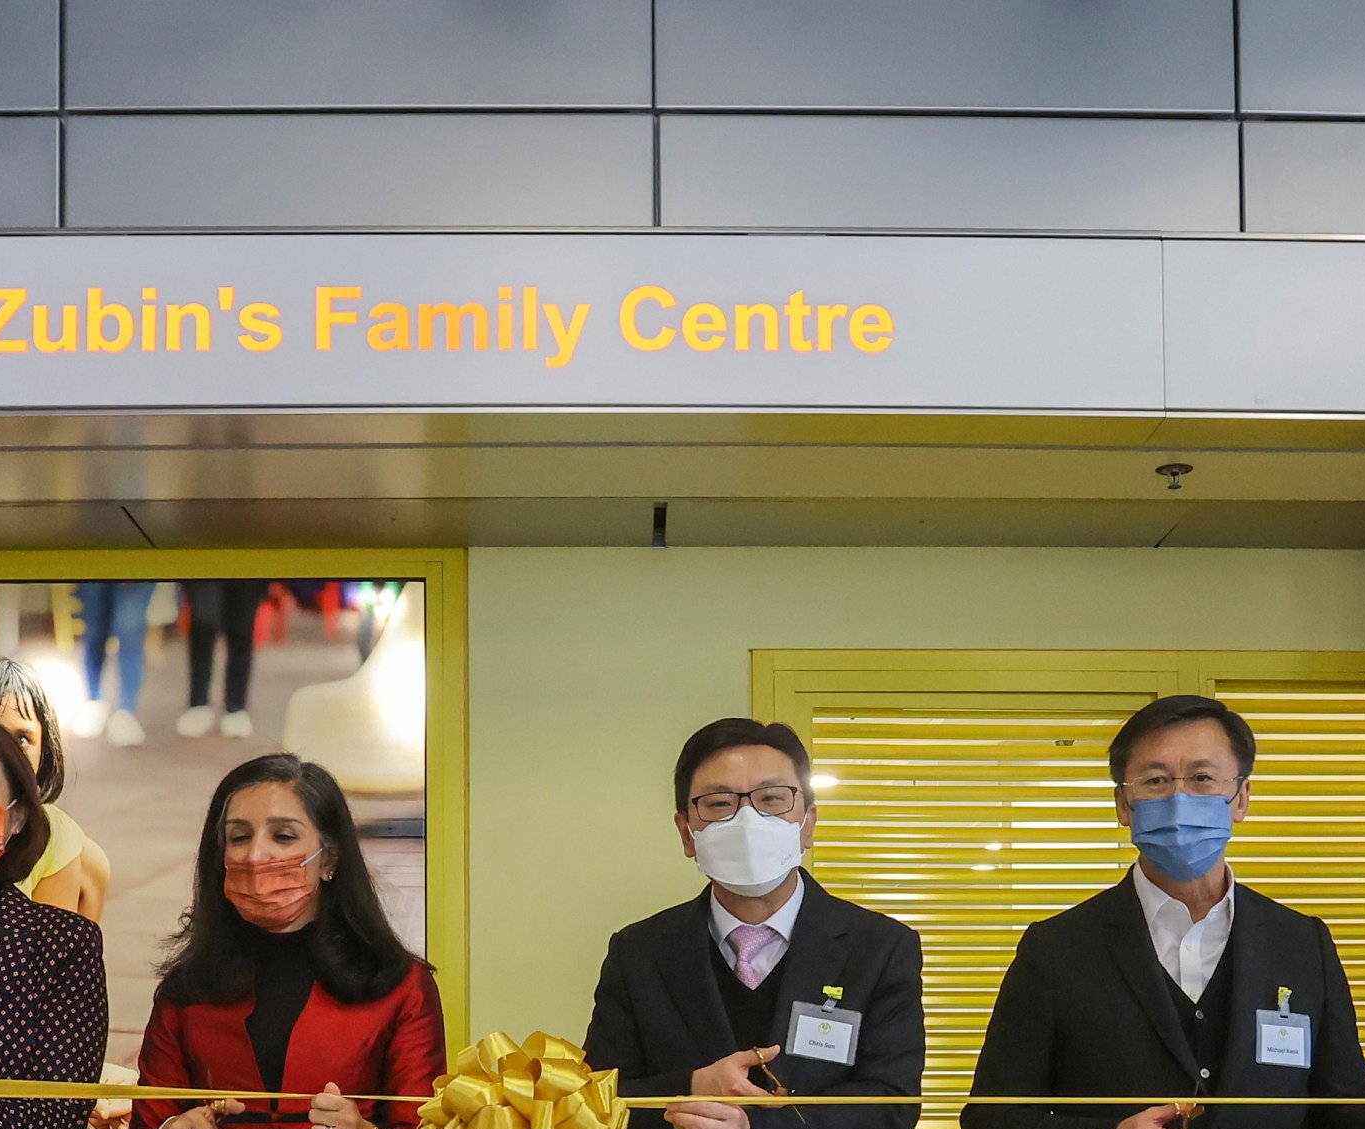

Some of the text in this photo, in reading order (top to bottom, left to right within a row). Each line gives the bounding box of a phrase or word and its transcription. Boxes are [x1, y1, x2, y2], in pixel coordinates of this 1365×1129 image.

[314, 285, 591, 370] Family
[618, 284, 896, 354] Centre
[808, 1039, 836, 1050] Chris Sun
